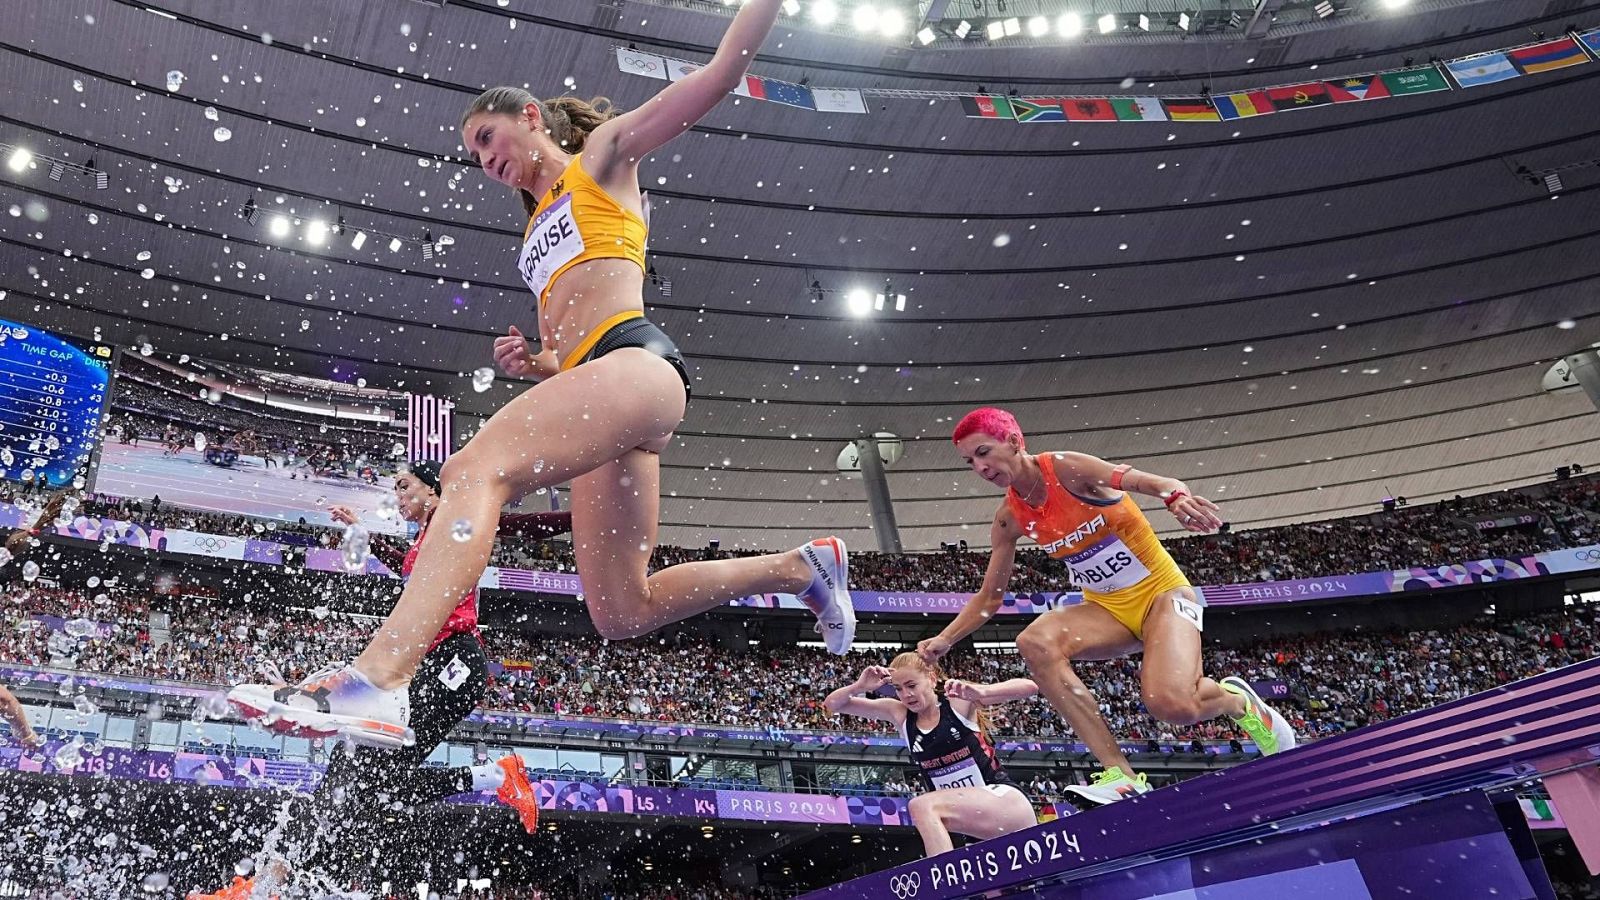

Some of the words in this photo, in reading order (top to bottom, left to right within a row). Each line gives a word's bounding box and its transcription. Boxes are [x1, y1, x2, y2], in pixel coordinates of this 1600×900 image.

[20, 342, 48, 356] TIME
[49, 349, 74, 362] GAP
[84, 356, 109, 370] DIST.
[45, 372, 68, 384] +0.3
[42, 384, 65, 395] +0.6
[39, 396, 62, 407] +0.8
[36, 408, 60, 419] +1.0
[1043, 513, 1106, 554] SPAÑA
[1298, 580, 1347, 595] 2024
[1272, 684, 1288, 695] K9
[148, 759, 171, 779] L6
[637, 796, 655, 811] L5
[789, 804, 836, 816] 2024
[1006, 830, 1080, 870] 2024
